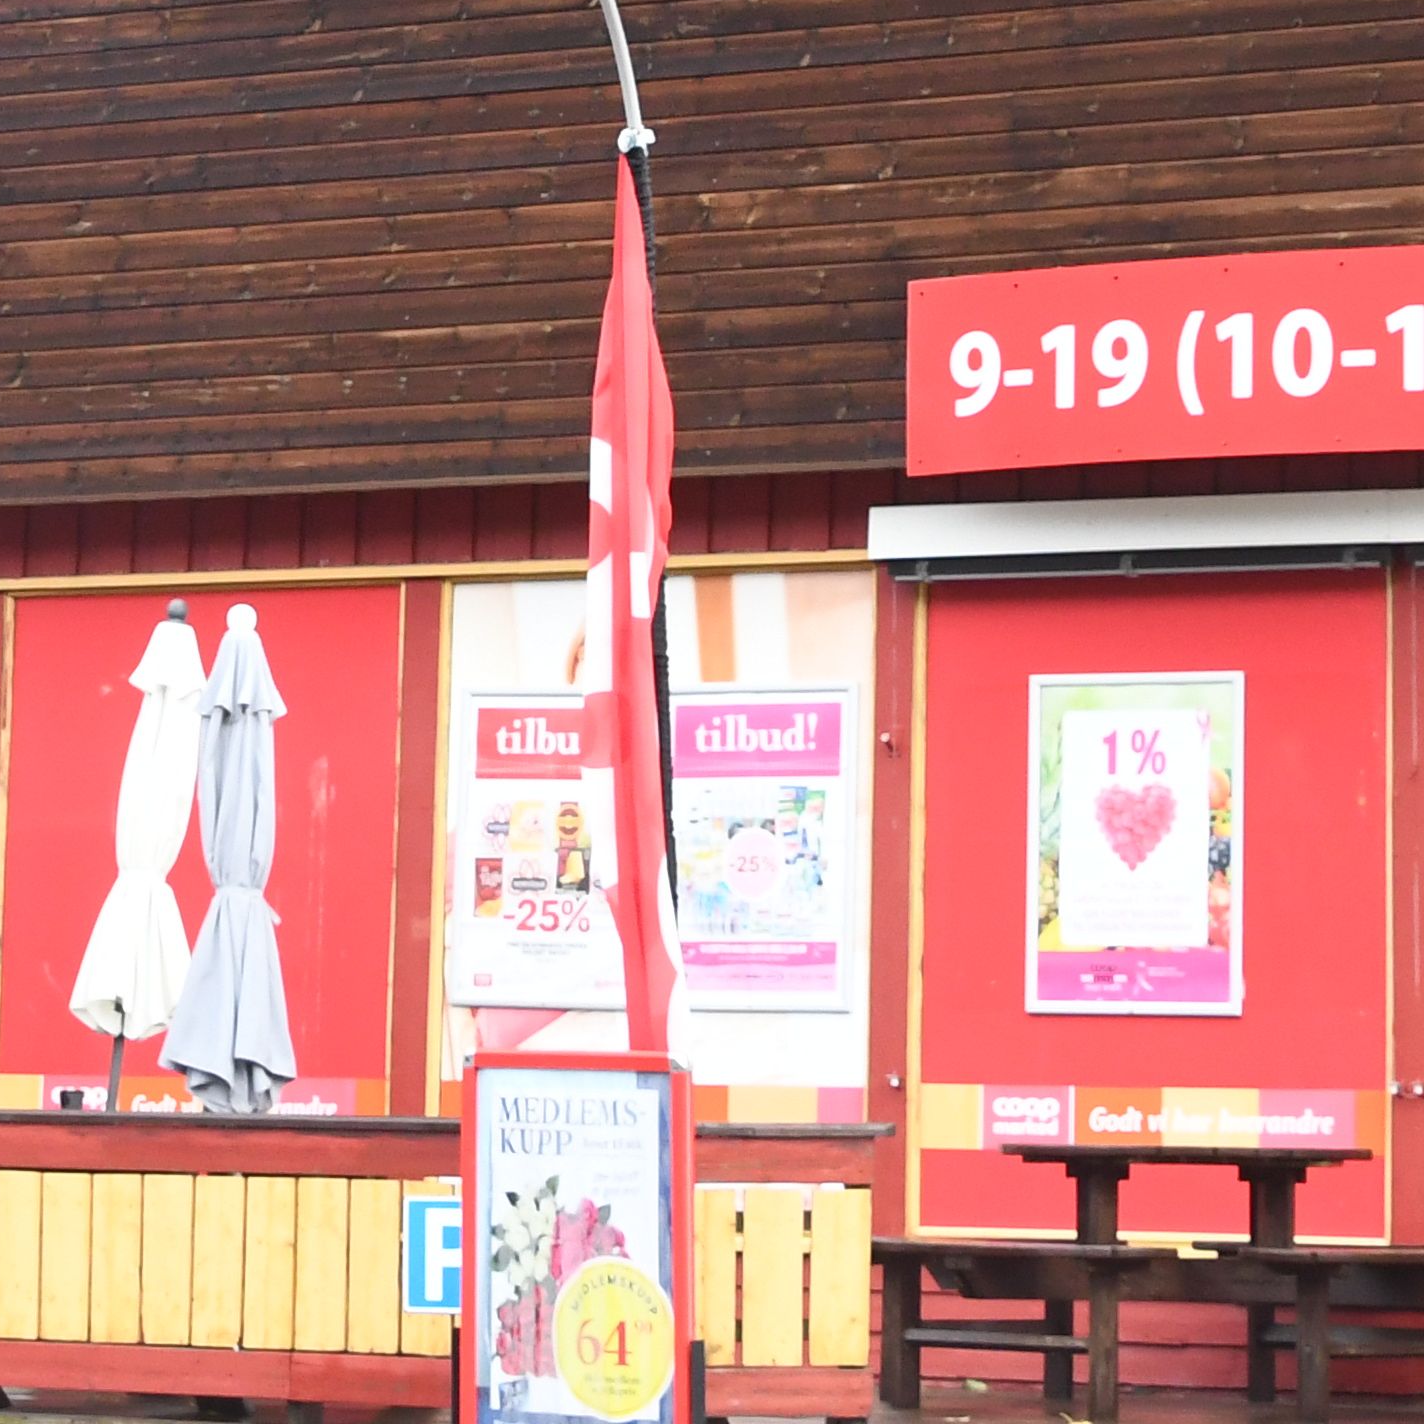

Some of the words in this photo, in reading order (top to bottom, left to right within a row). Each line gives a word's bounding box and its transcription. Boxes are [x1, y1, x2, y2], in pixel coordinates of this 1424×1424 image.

[949, 319, 1149, 418] 9-19
[496, 717, 581, 755] tilbu
[695, 712, 818, 753] tilbud!
[503, 899, 590, 933] -25%
[992, 1096, 1060, 1121] coop
[1088, 1106, 1143, 1132] Godt
[500, 1128, 573, 1156] KUPP
